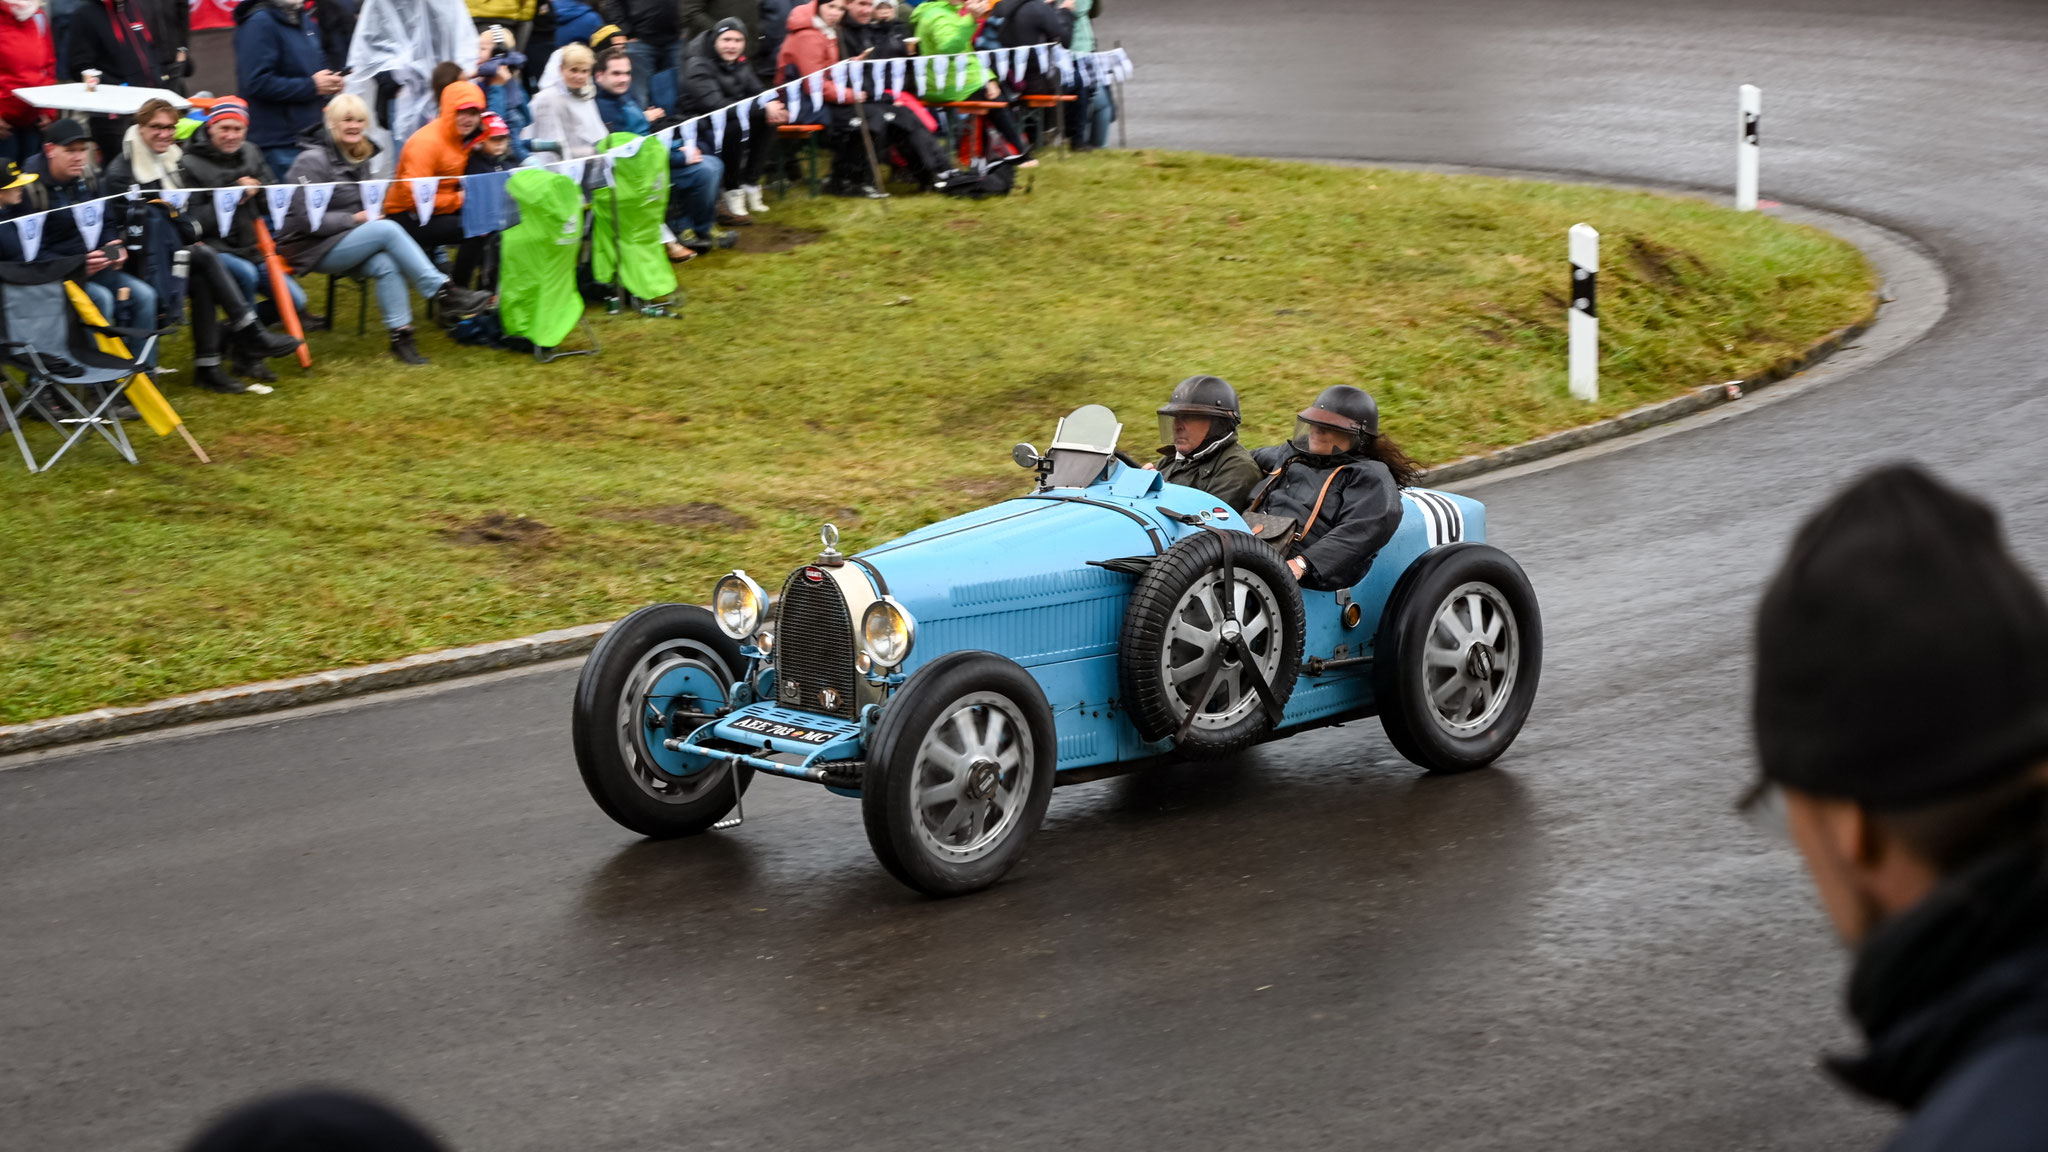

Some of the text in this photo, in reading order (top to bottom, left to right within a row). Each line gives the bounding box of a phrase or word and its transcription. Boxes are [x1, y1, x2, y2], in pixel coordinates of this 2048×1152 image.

[734, 718, 833, 743] AEE 703 MC
